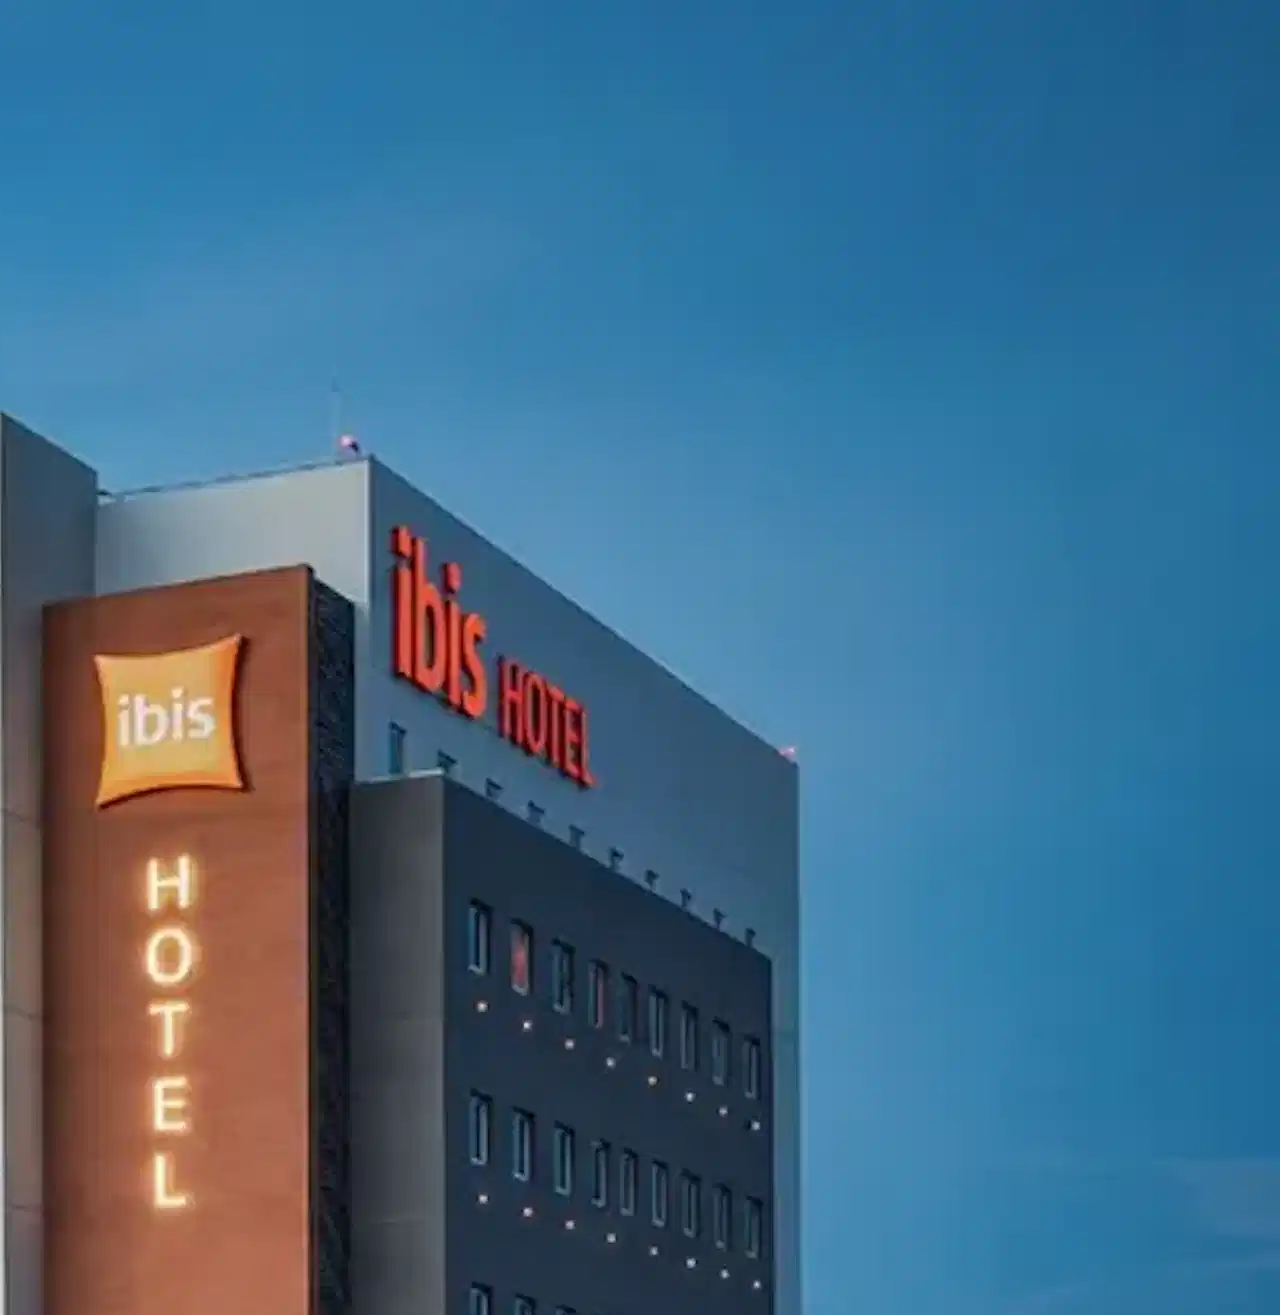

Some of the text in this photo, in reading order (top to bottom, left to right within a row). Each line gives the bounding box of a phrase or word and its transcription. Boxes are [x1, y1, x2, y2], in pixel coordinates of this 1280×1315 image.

[117, 686, 217, 747] ibis
[392, 525, 597, 792] ibis HOTEL
[145, 853, 194, 1209] HOTEL
